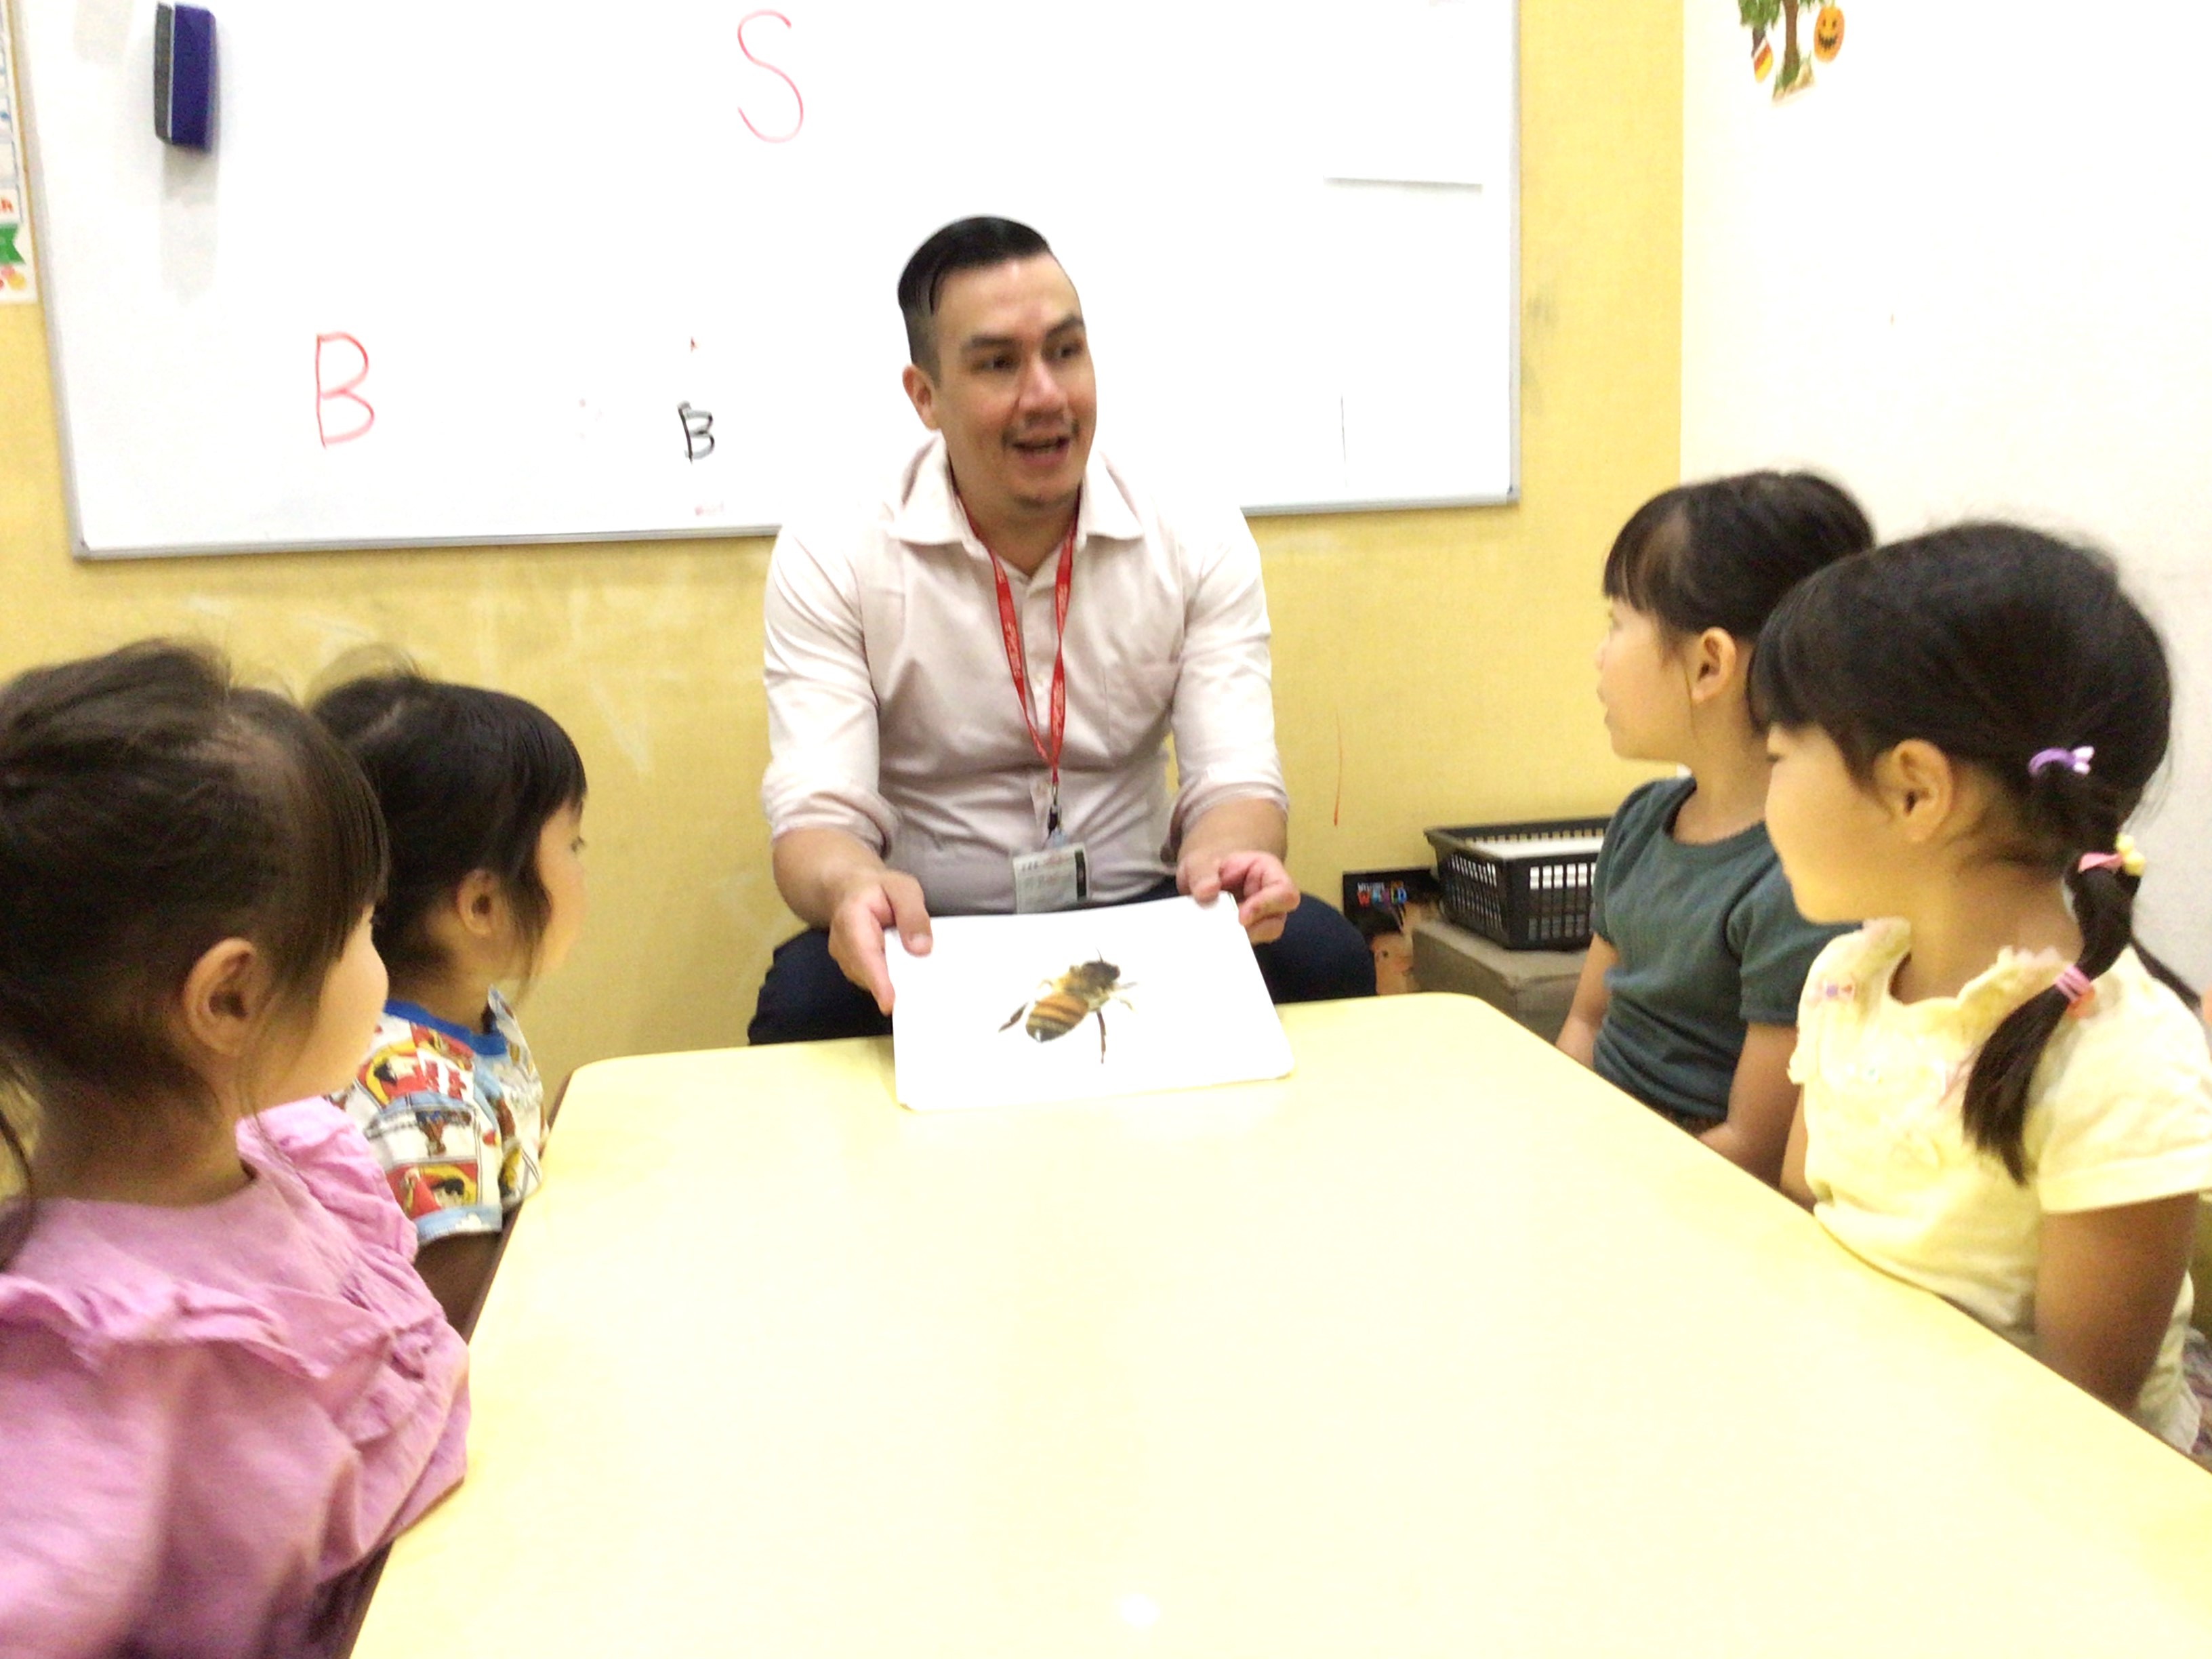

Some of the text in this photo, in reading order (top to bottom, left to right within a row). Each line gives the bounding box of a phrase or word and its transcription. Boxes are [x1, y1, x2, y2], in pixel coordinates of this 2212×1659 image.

[737, 10, 804, 142] S
[314, 331, 375, 450] B
[676, 400, 716, 464] B
